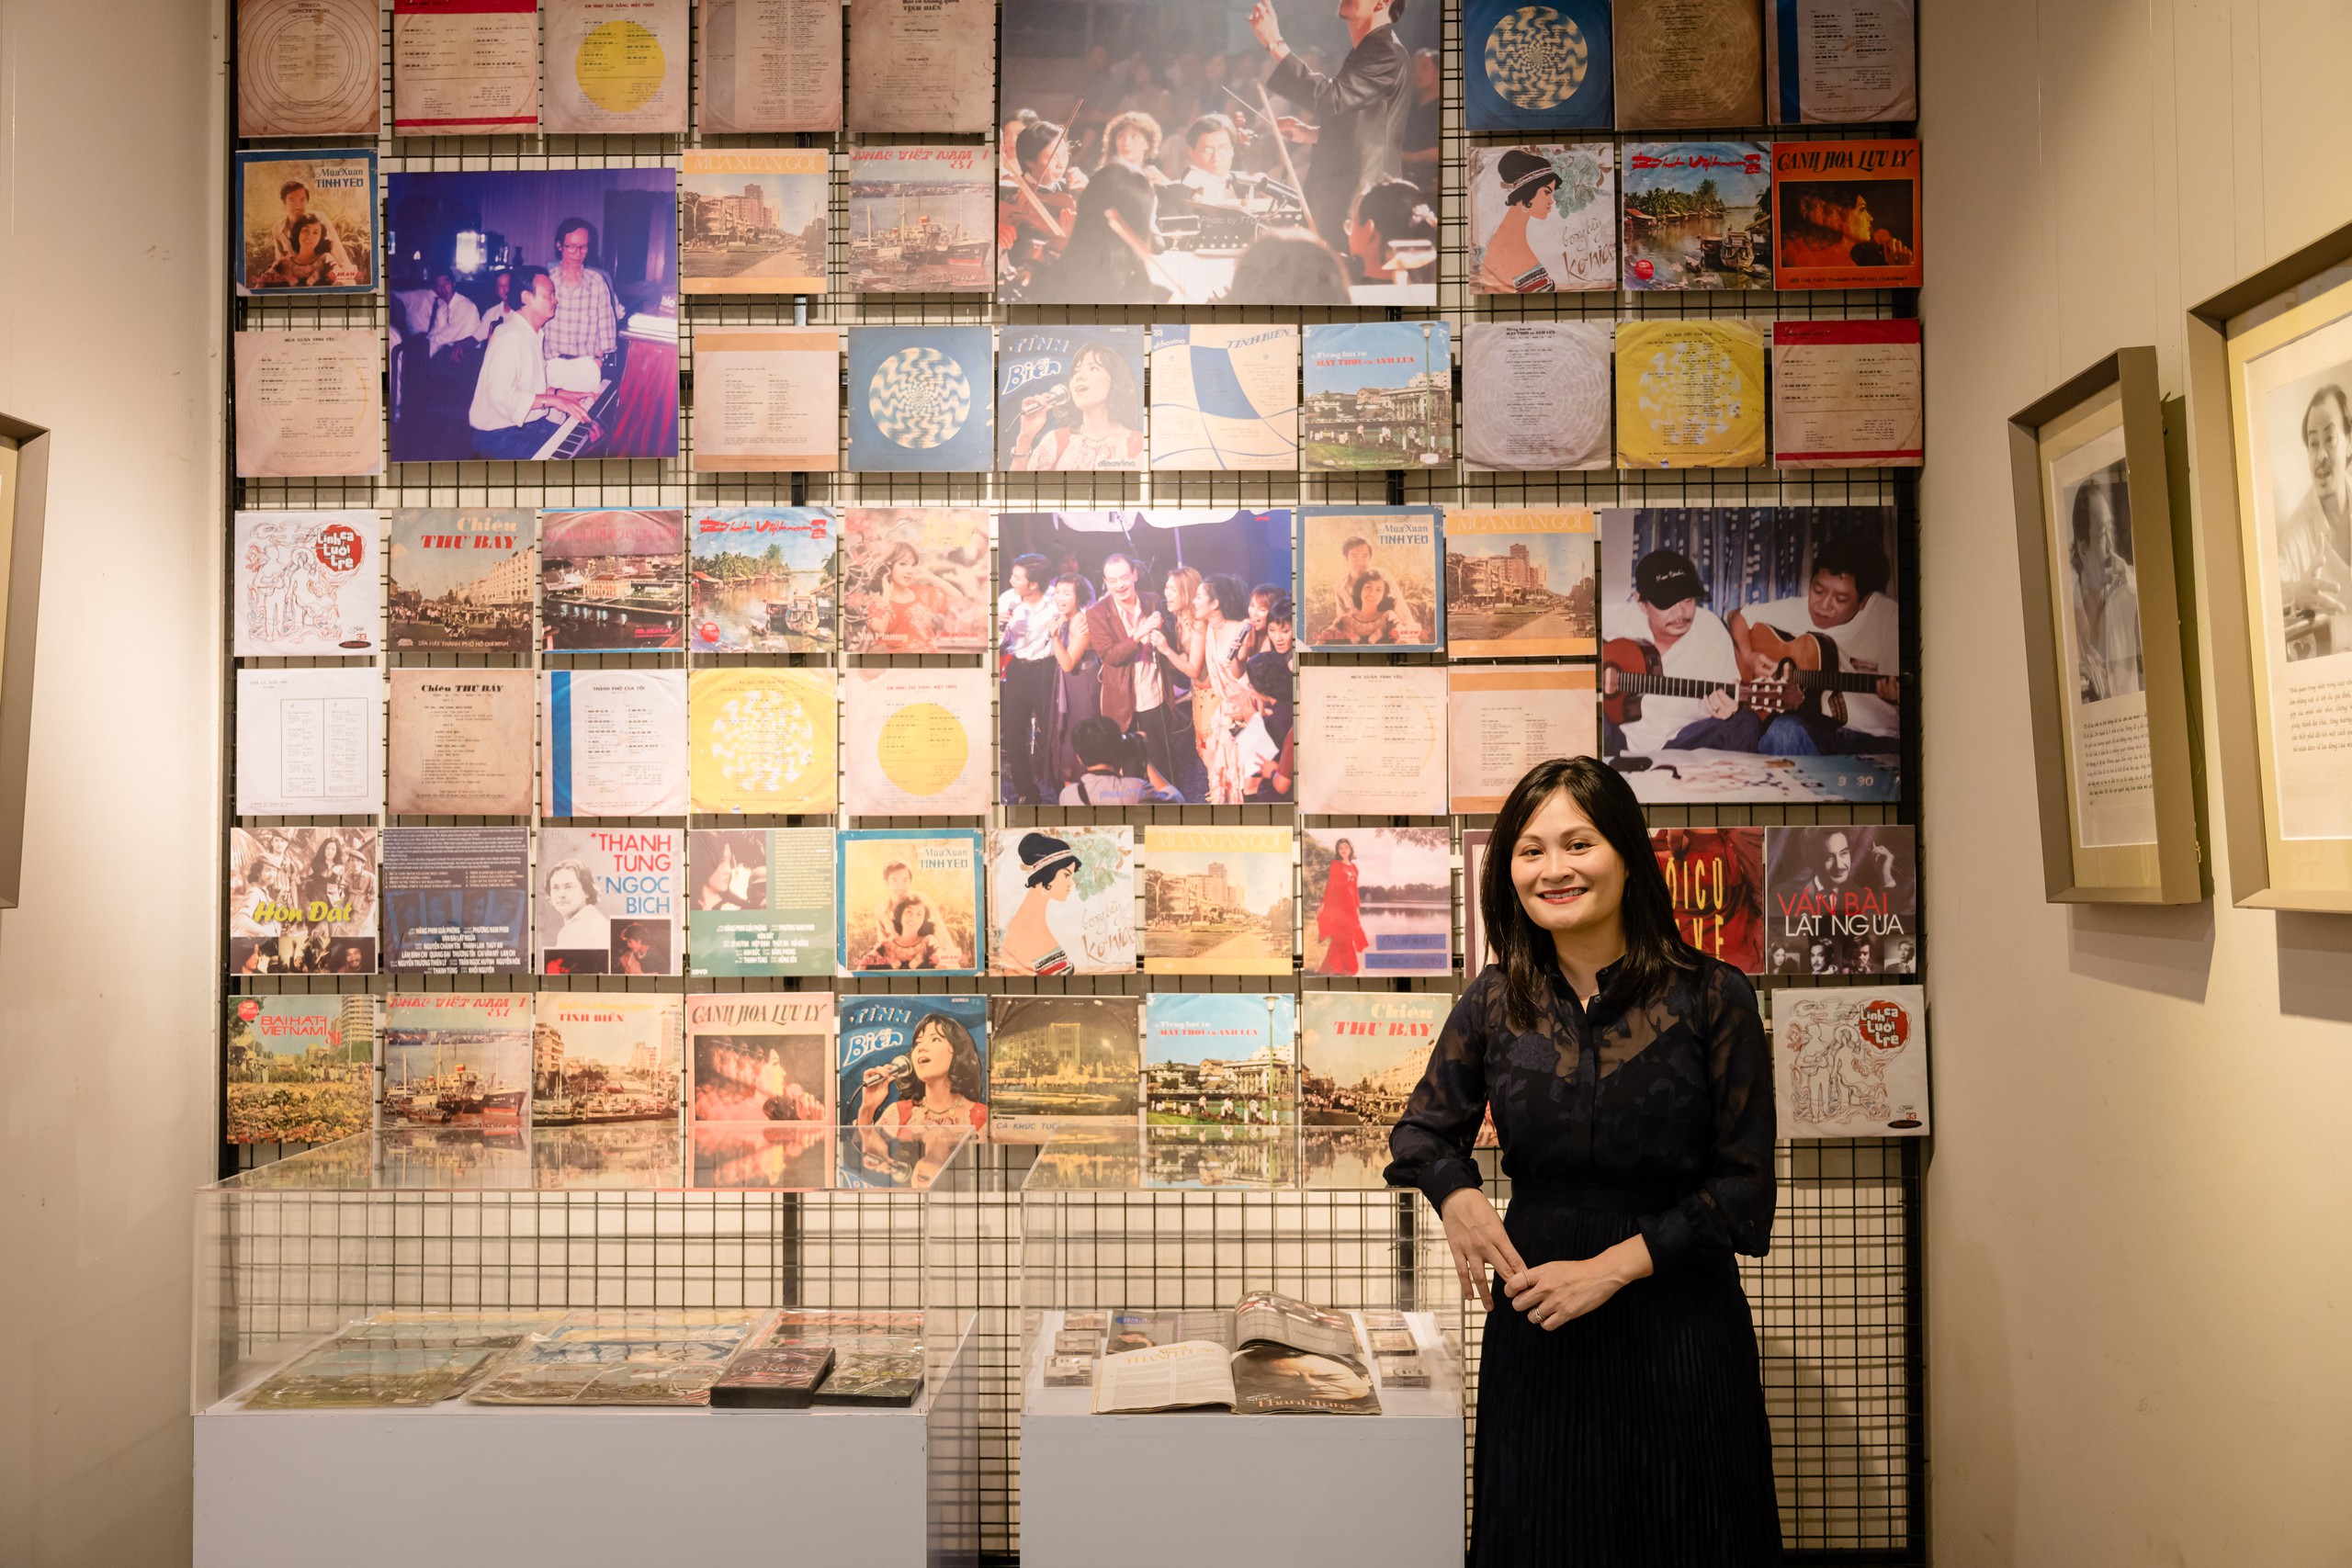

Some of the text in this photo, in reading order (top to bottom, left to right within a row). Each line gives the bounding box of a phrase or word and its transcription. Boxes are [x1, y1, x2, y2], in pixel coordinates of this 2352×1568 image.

[1201, 216, 1225, 224] Photo
[1227, 216, 1238, 226] by
[598, 834, 672, 852] THANH
[1777, 886, 1888, 917] VÁN BÀI
